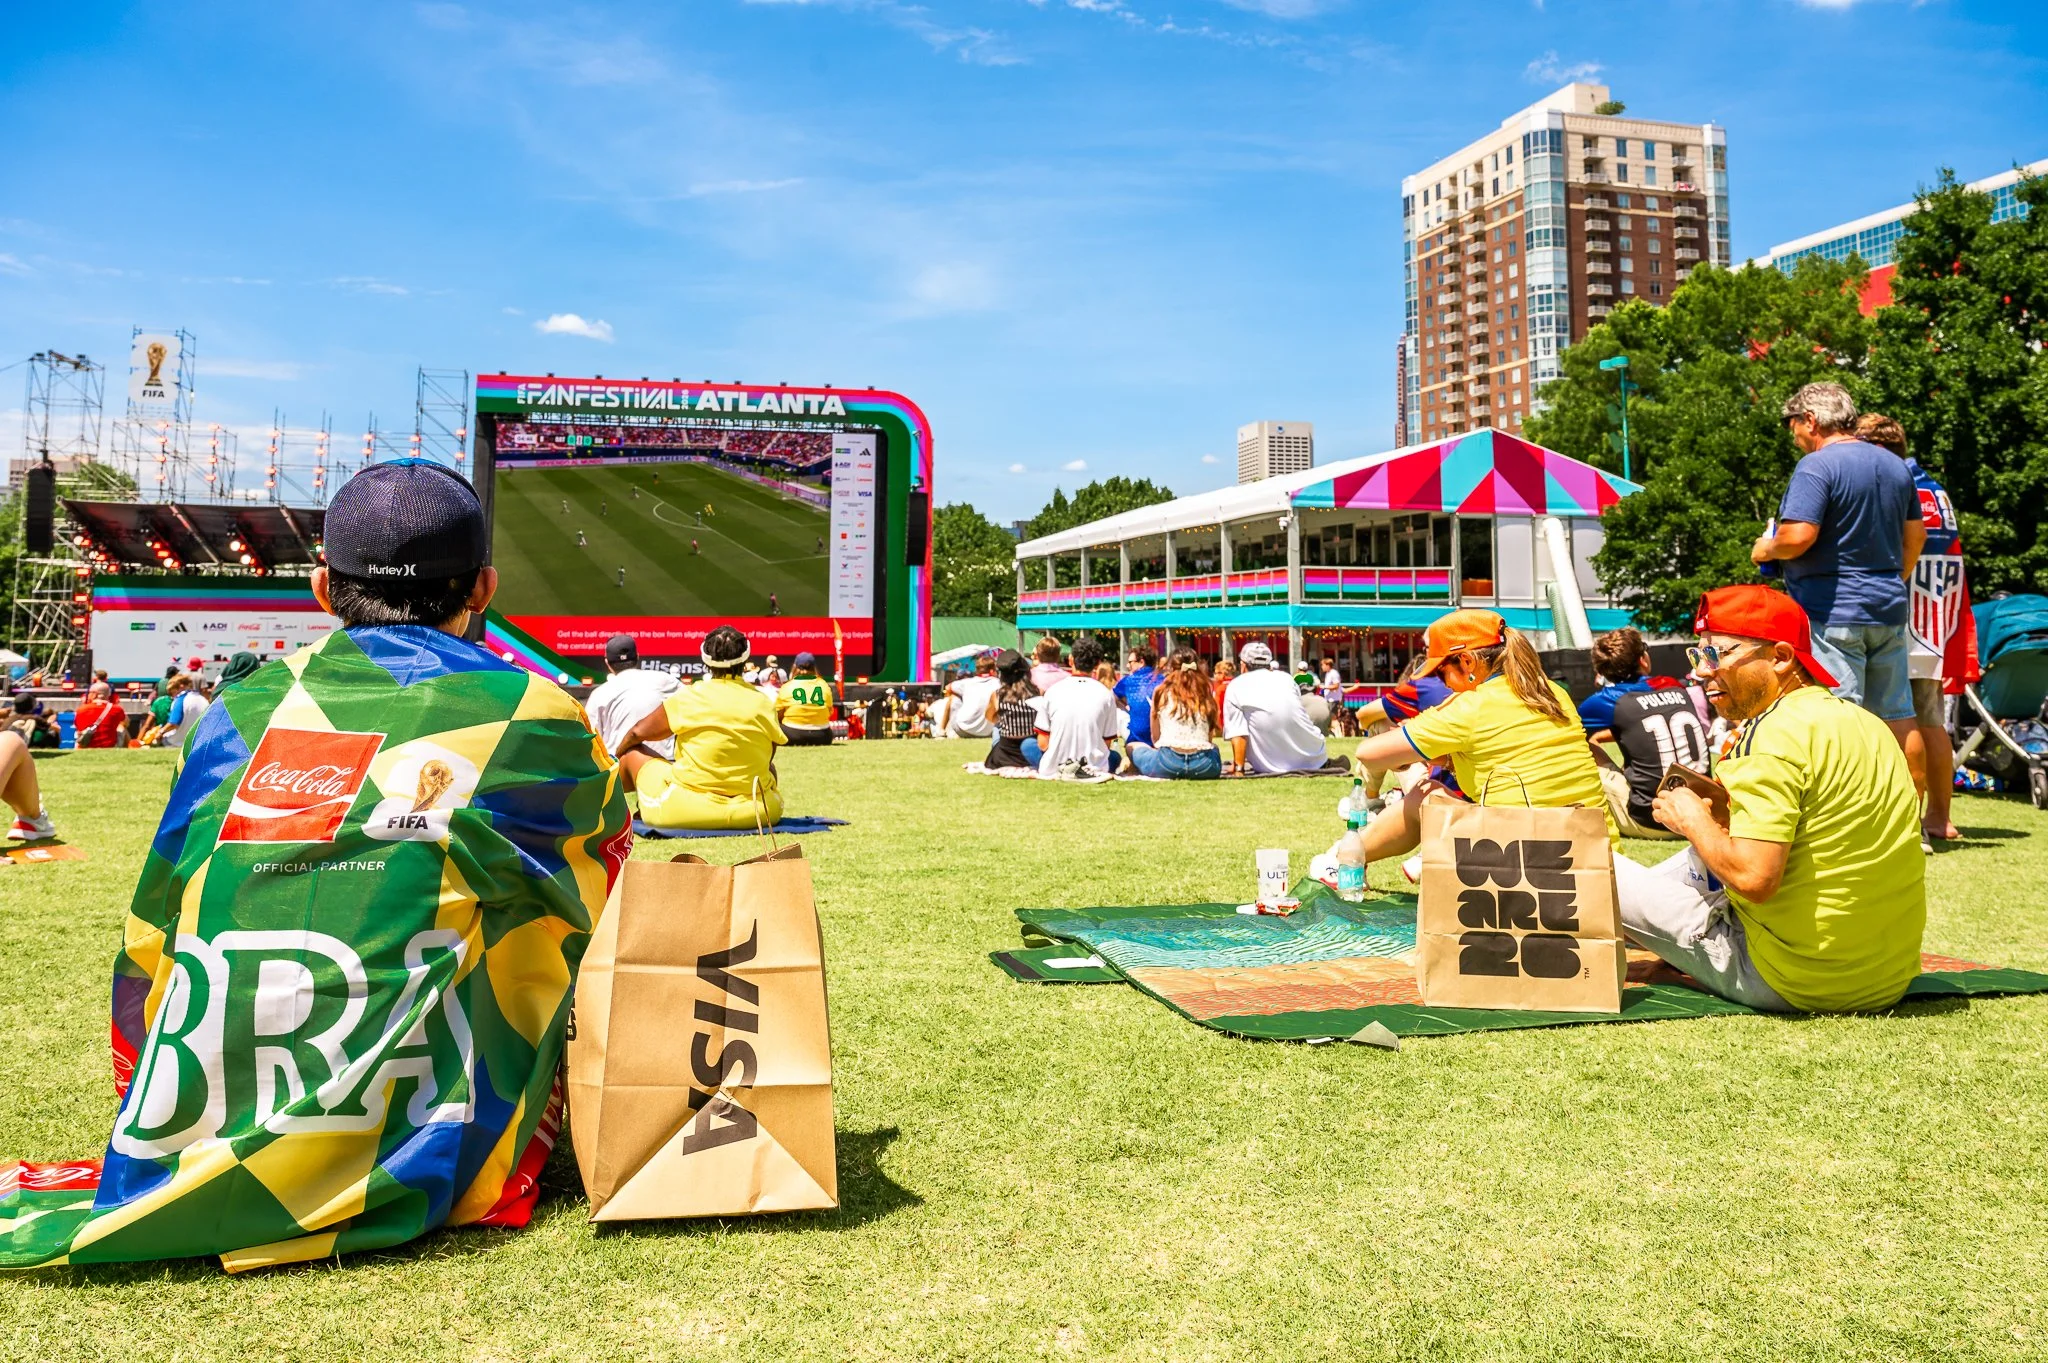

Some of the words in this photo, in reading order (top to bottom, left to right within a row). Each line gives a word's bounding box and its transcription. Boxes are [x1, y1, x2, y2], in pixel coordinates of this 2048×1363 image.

[142, 389, 165, 398] FIFA
[517, 383, 526, 404] FIFA
[681, 388, 689, 410] 2026
[695, 390, 846, 416] ATLANTA
[368, 564, 403, 576] Hurley
[640, 630, 652, 638] the
[652, 630, 665, 638] box
[666, 630, 683, 638] from
[768, 630, 786, 639] pitch
[801, 630, 826, 640] players
[792, 686, 825, 706] 94
[1636, 691, 1687, 710] PULISIC
[1641, 710, 1709, 777] 10
[247, 761, 358, 797] Coca-Cola
[387, 815, 429, 830] FIFA
[252, 862, 315, 873] OFFICIAL
[320, 861, 386, 872] PARTNER
[1454, 837, 1577, 891] WE
[1458, 931, 1582, 979] 26
[113, 930, 475, 1157] BRA
[682, 918, 760, 1156] VISA
